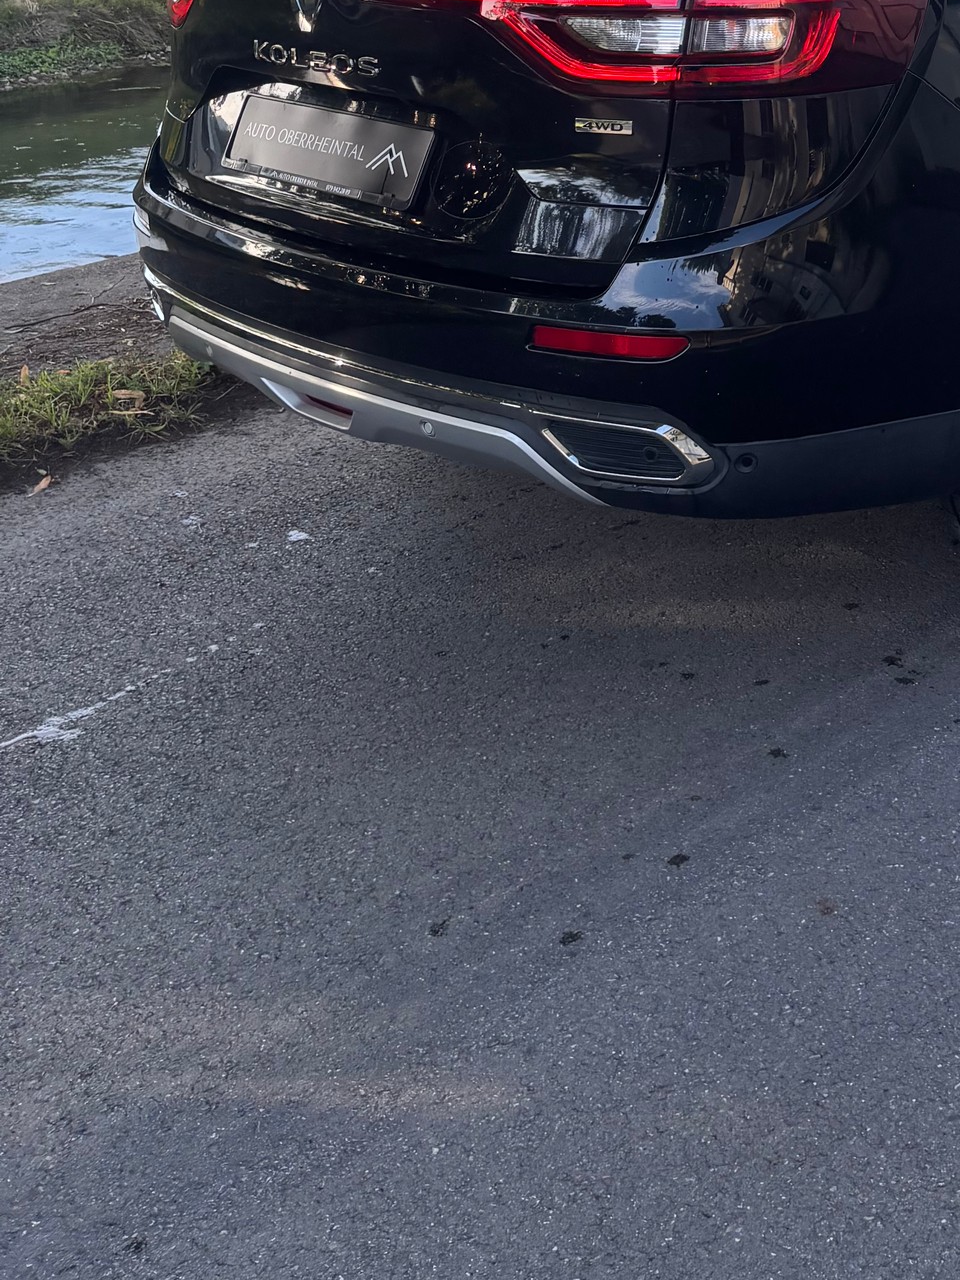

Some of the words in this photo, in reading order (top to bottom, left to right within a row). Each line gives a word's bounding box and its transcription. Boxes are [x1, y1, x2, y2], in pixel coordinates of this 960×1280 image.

[253, 39, 380, 76] KOLEOS
[244, 122, 276, 141] AUTO
[277, 128, 364, 161] OBERRHEINTAL
[582, 120, 624, 132] 4WD
